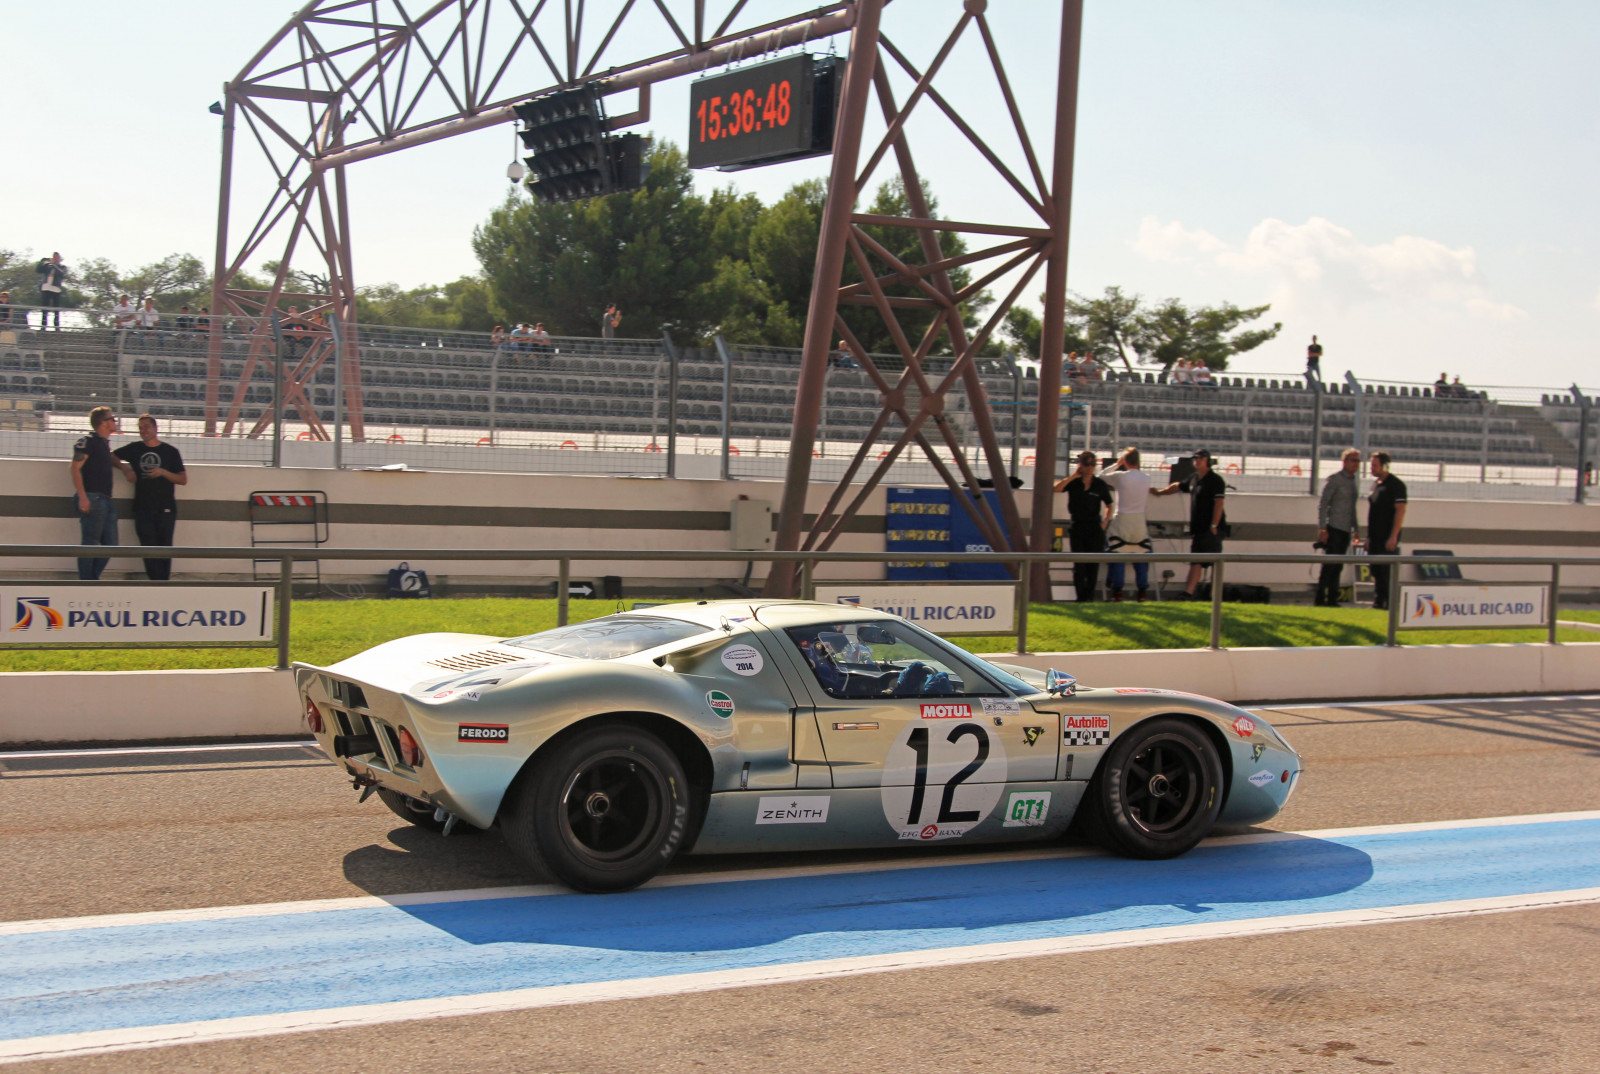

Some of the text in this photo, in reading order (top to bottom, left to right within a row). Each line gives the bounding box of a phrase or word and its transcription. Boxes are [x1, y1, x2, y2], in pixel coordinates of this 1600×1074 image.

[697, 80, 791, 142] 15:36:48
[924, 605, 996, 620] RICARD
[1442, 602, 1534, 616] PAUL RICARD
[68, 609, 246, 628] PAUL RICARD
[736, 662, 754, 671] 2014
[711, 700, 732, 708] Castrol
[923, 705, 971, 717] MOTUL
[1066, 716, 1108, 729] Autolite
[461, 728, 506, 738] FERODO
[906, 722, 990, 825] 12
[763, 809, 822, 819] ZENITH
[1011, 799, 1045, 820] GT1
